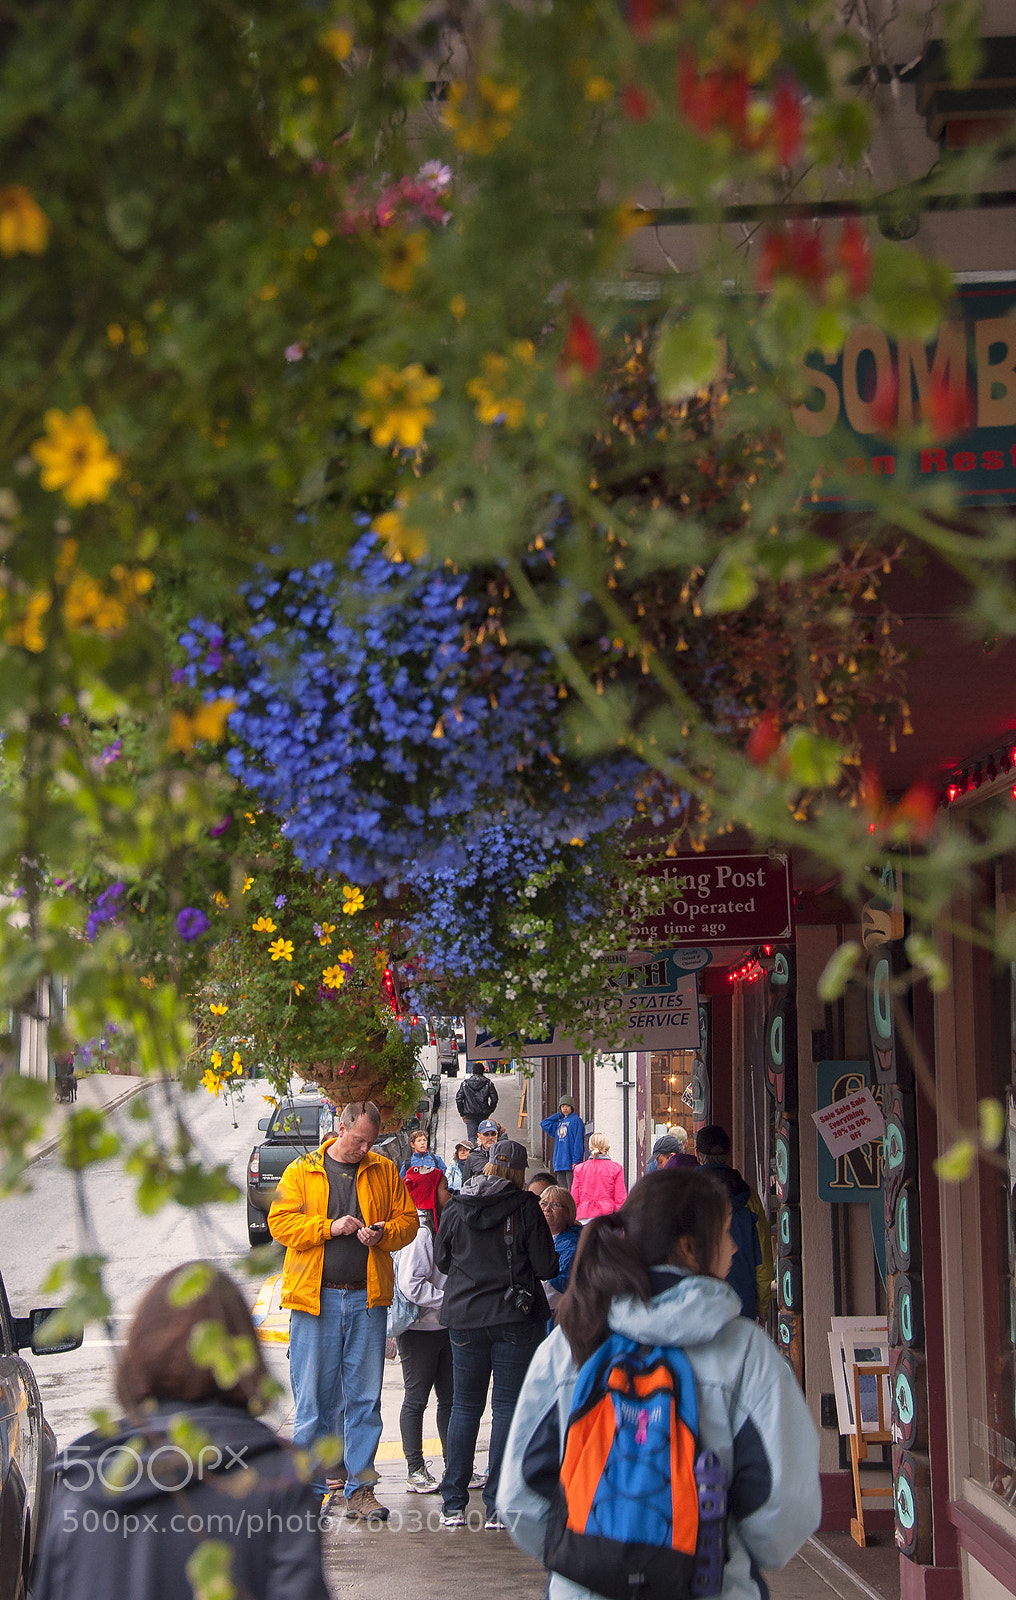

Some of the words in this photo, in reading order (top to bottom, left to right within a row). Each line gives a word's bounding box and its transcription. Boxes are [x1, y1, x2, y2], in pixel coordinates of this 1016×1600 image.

[715, 866, 766, 888] Post
[673, 897, 756, 920] Operated
[664, 921, 696, 934] time
[701, 923, 726, 936] ago
[628, 994, 684, 1010] STATES
[628, 1013, 690, 1029] SERVICE
[819, 1112, 836, 1124] Sale
[834, 1104, 851, 1116] Sale
[850, 1096, 867, 1108] Sale
[828, 1108, 865, 1130] Everything
[847, 1123, 856, 1131] to
[850, 1130, 862, 1141] OFF
